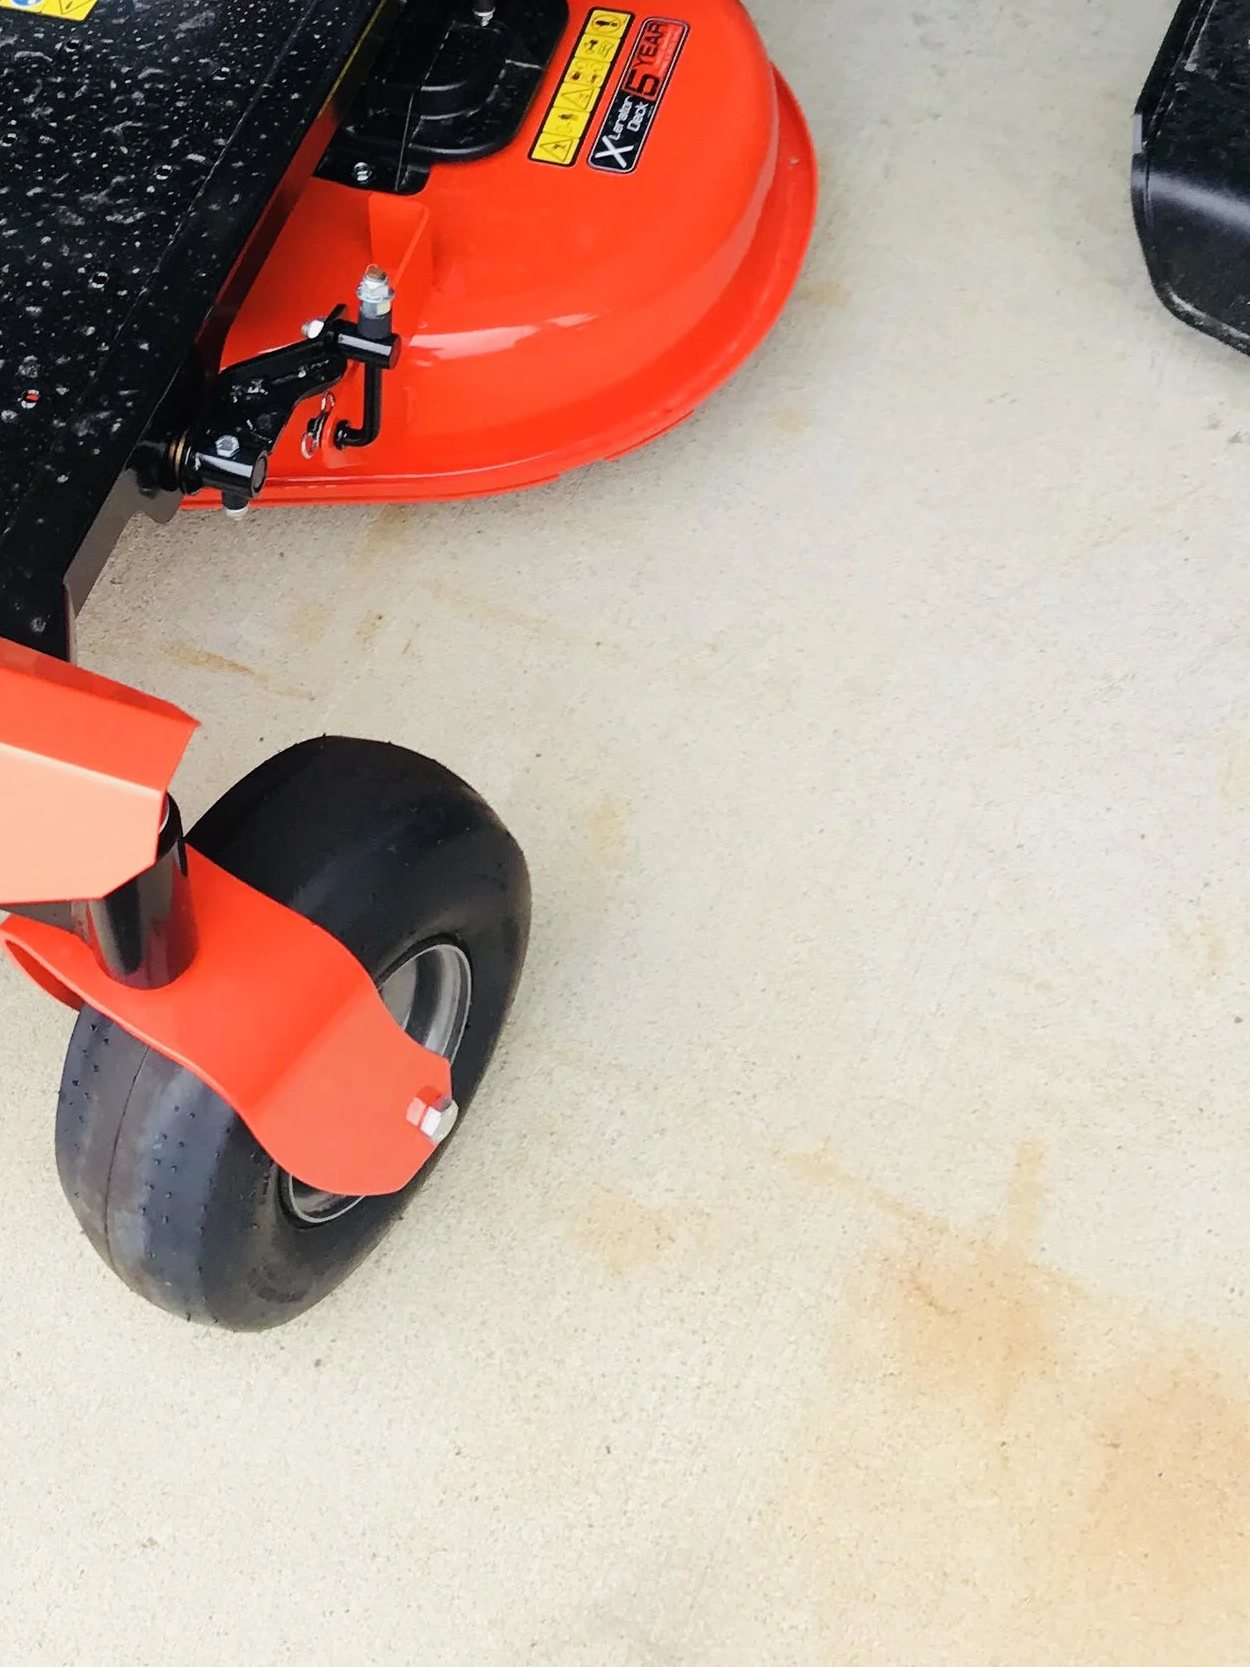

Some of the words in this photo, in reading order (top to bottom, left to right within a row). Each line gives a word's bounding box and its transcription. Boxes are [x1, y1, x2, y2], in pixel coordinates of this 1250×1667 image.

[632, 22, 664, 69] YEAR
[624, 69, 661, 97] 5
[627, 102, 649, 132] Deck
